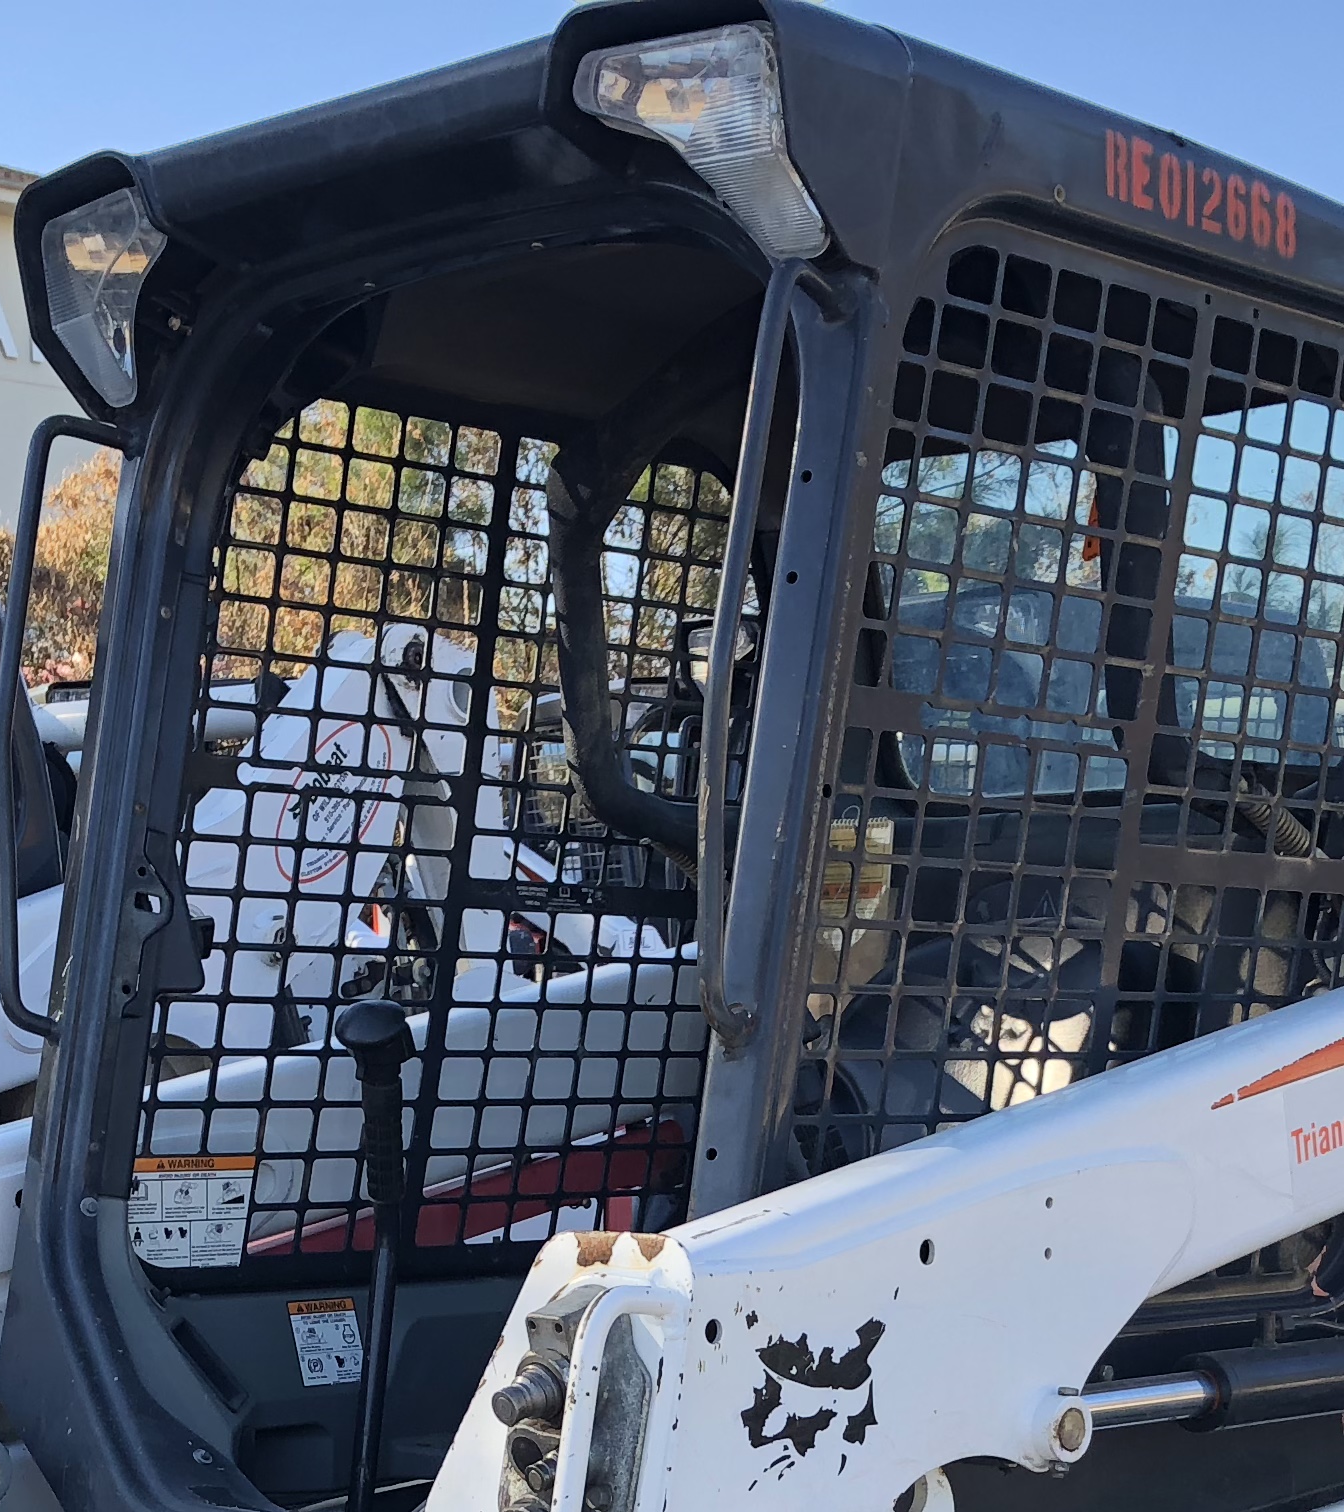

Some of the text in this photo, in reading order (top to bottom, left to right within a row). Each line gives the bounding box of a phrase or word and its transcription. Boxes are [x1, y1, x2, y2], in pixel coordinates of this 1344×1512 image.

[1106, 128, 1297, 260] RE012668
[167, 1158, 215, 1169] WARNING
[306, 1301, 347, 1311] WARNING
